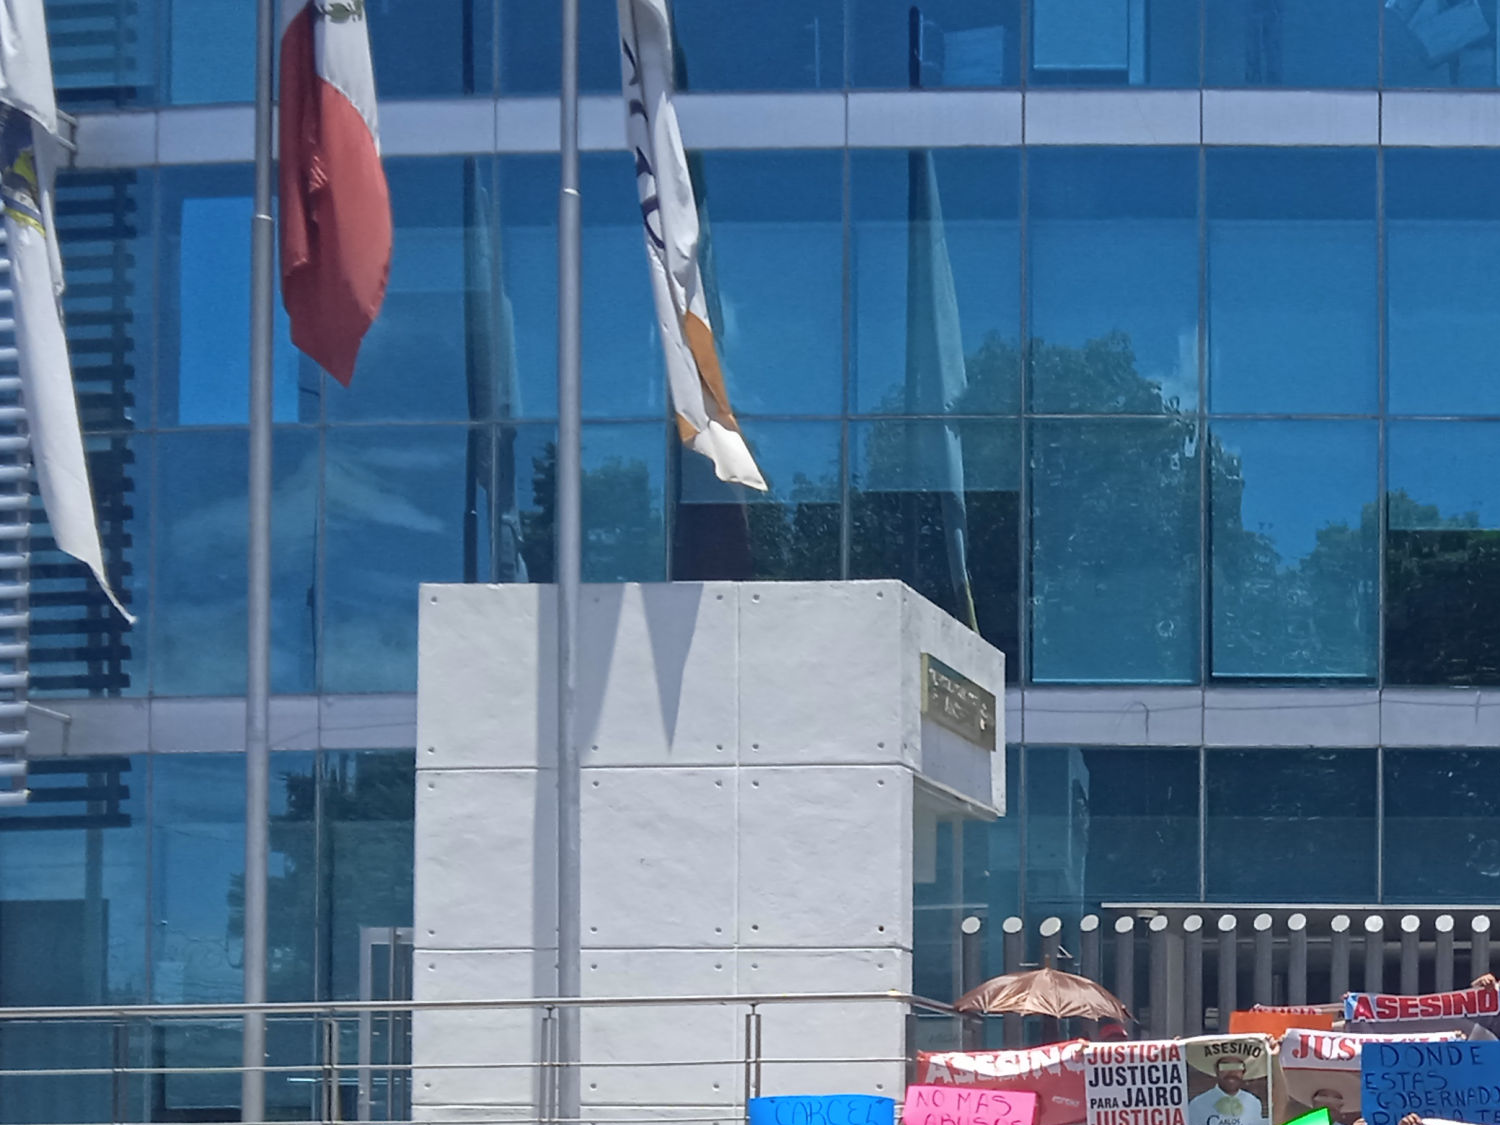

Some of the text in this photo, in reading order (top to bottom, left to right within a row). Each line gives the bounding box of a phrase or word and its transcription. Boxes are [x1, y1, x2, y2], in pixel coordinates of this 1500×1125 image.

[1353, 988, 1499, 1022] ASESINO
[1087, 1043, 1181, 1066] JUSTICIA
[1203, 1042, 1262, 1059] ASESINO
[1379, 1044, 1486, 1069] DONDE
[1089, 1062, 1183, 1088] JUSTICIA
[1365, 1071, 1448, 1092] ESTAS
[957, 1092, 1013, 1116] MAS
[1091, 1096, 1119, 1109] PARA
[1122, 1086, 1183, 1109] JAIRO
